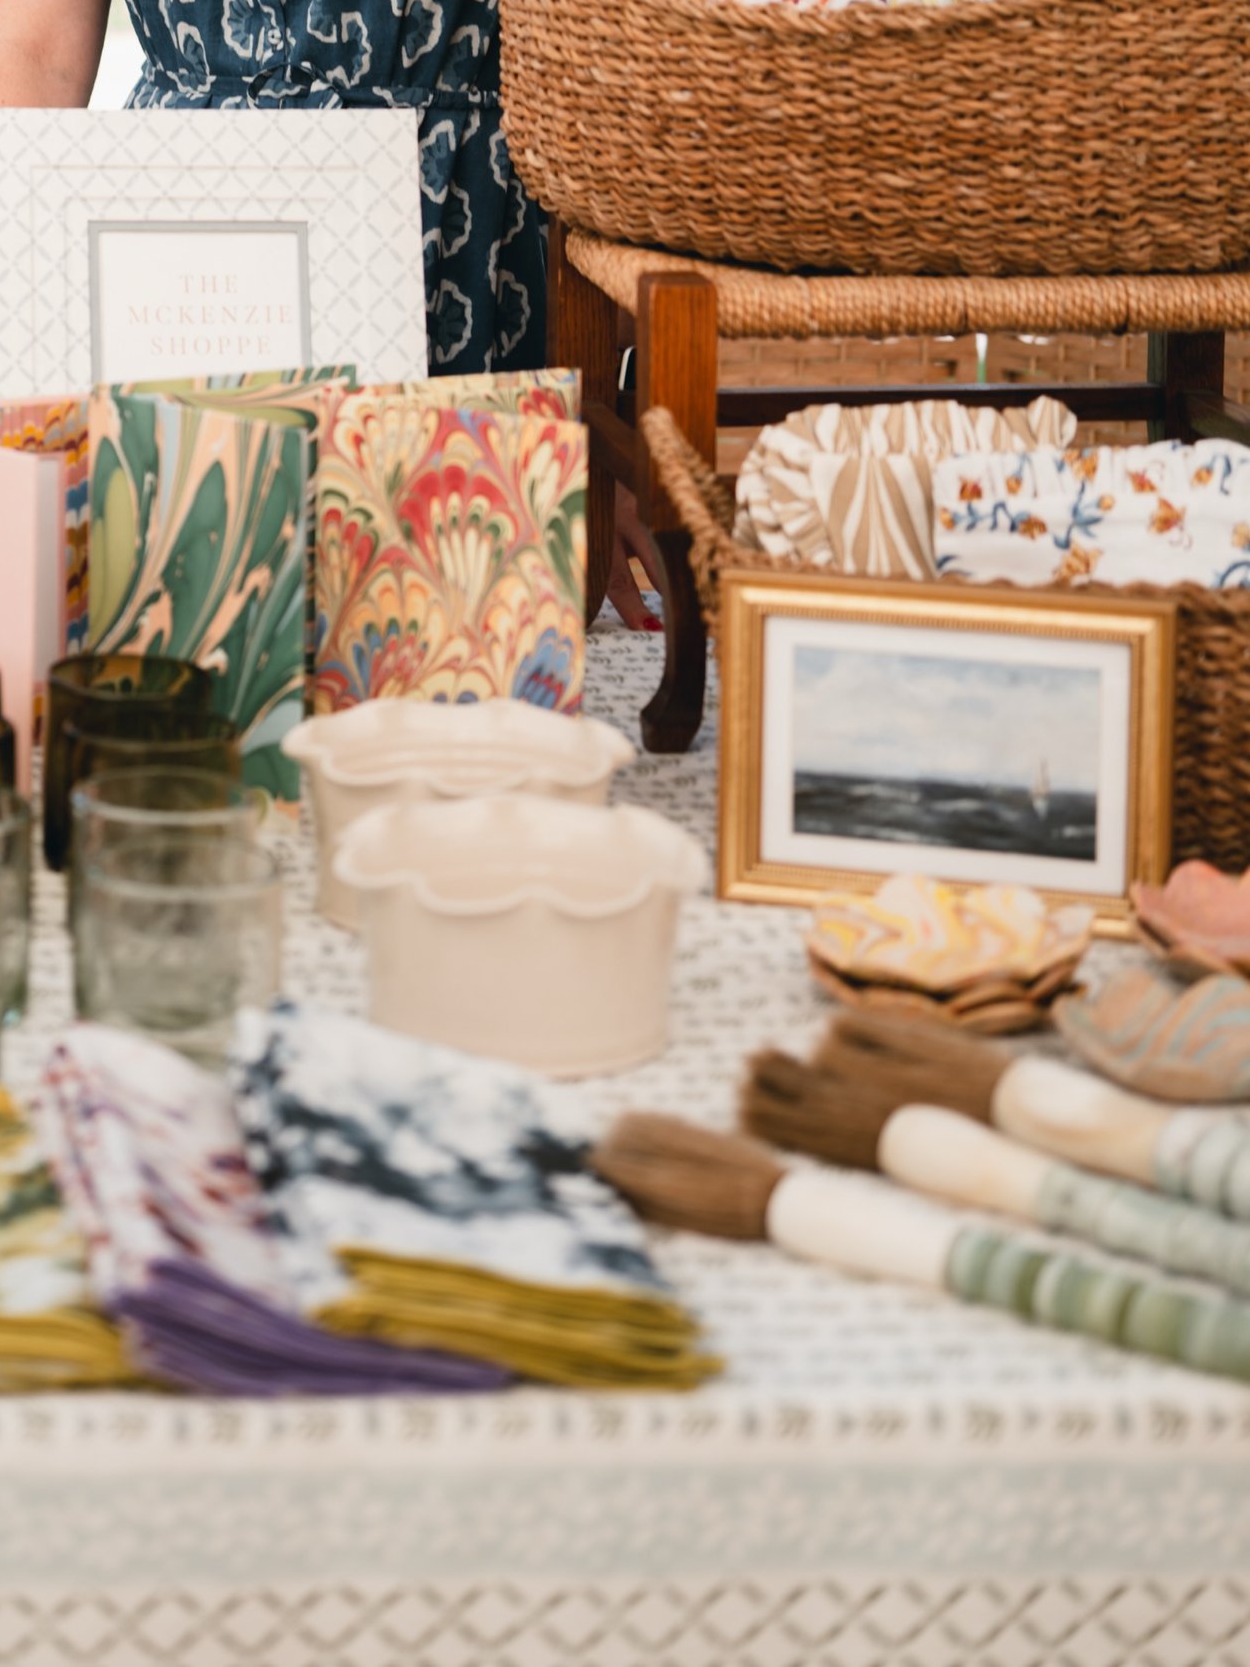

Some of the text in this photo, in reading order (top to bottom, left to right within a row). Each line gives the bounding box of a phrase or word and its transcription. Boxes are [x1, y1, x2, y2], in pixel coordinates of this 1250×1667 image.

[180, 274, 239, 294] THE
[127, 304, 293, 325] MCKENZIE
[150, 335, 272, 356] SHOPPE
